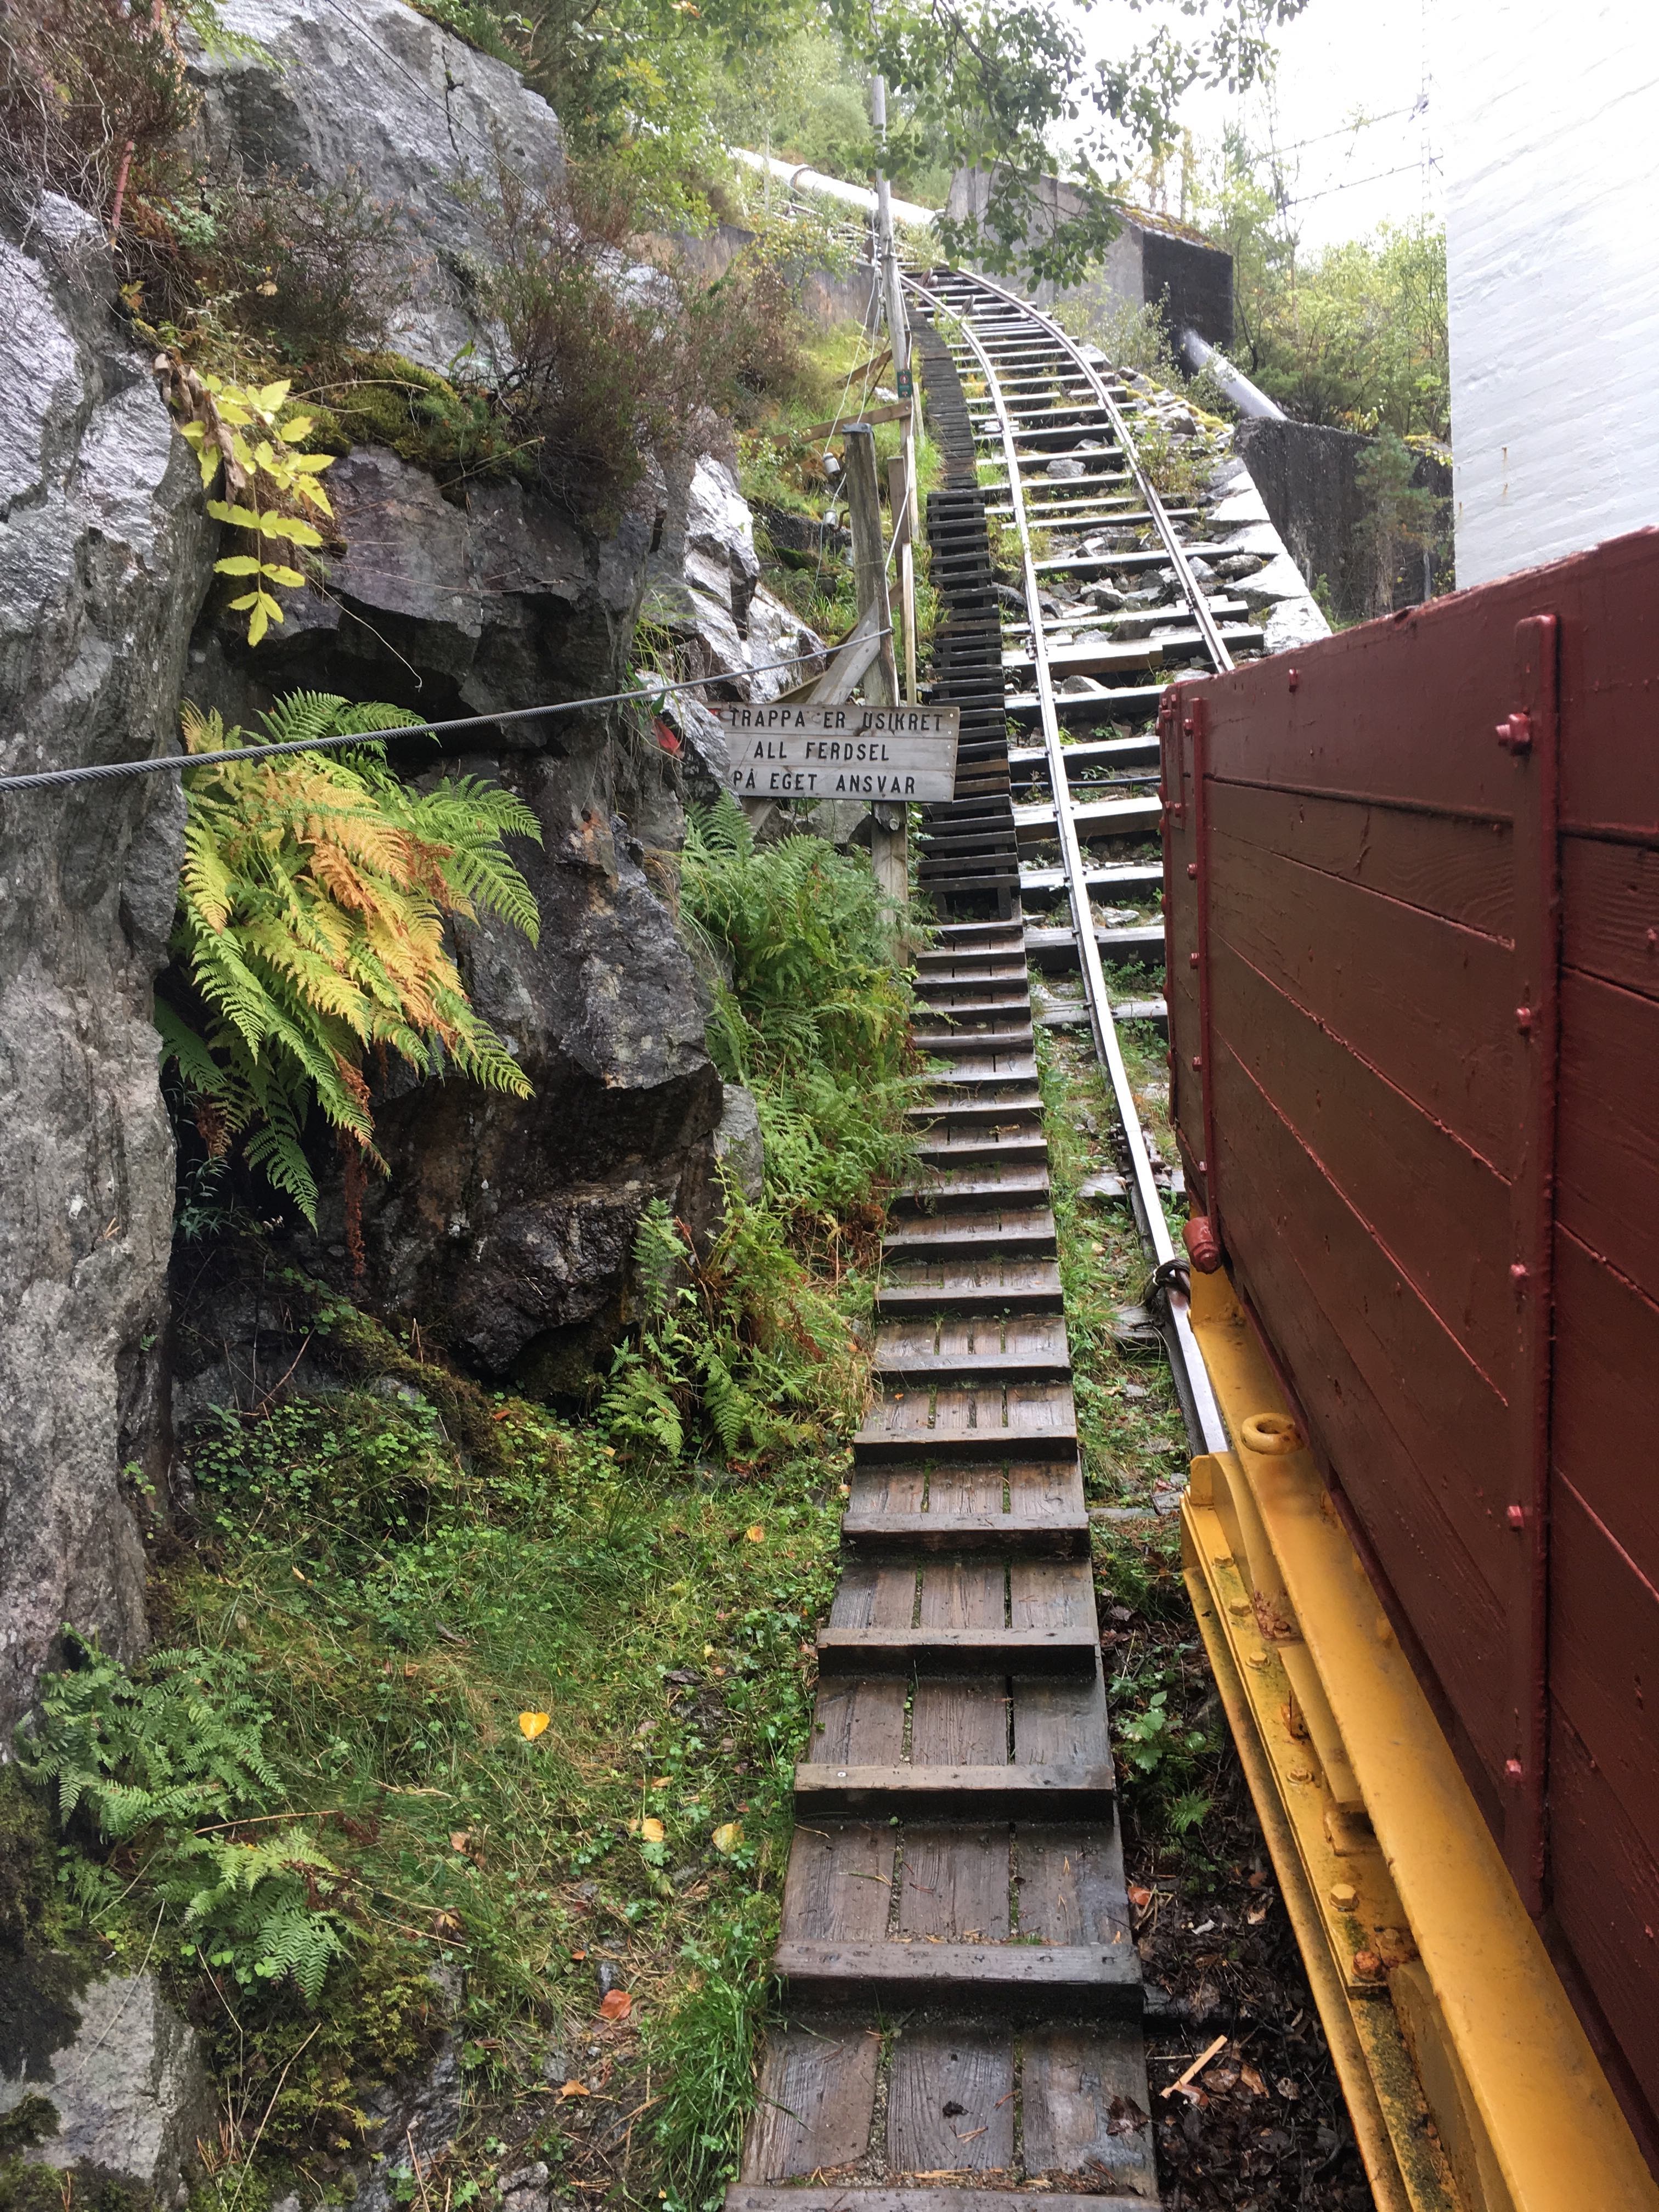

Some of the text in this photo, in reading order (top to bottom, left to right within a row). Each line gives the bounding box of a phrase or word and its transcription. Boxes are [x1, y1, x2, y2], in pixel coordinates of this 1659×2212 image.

[730, 708, 943, 731] TRAPPA ER USIKRET
[754, 741, 889, 761] ALL FERDSEL
[733, 768, 915, 794] PÅ EGET ANSVAR
